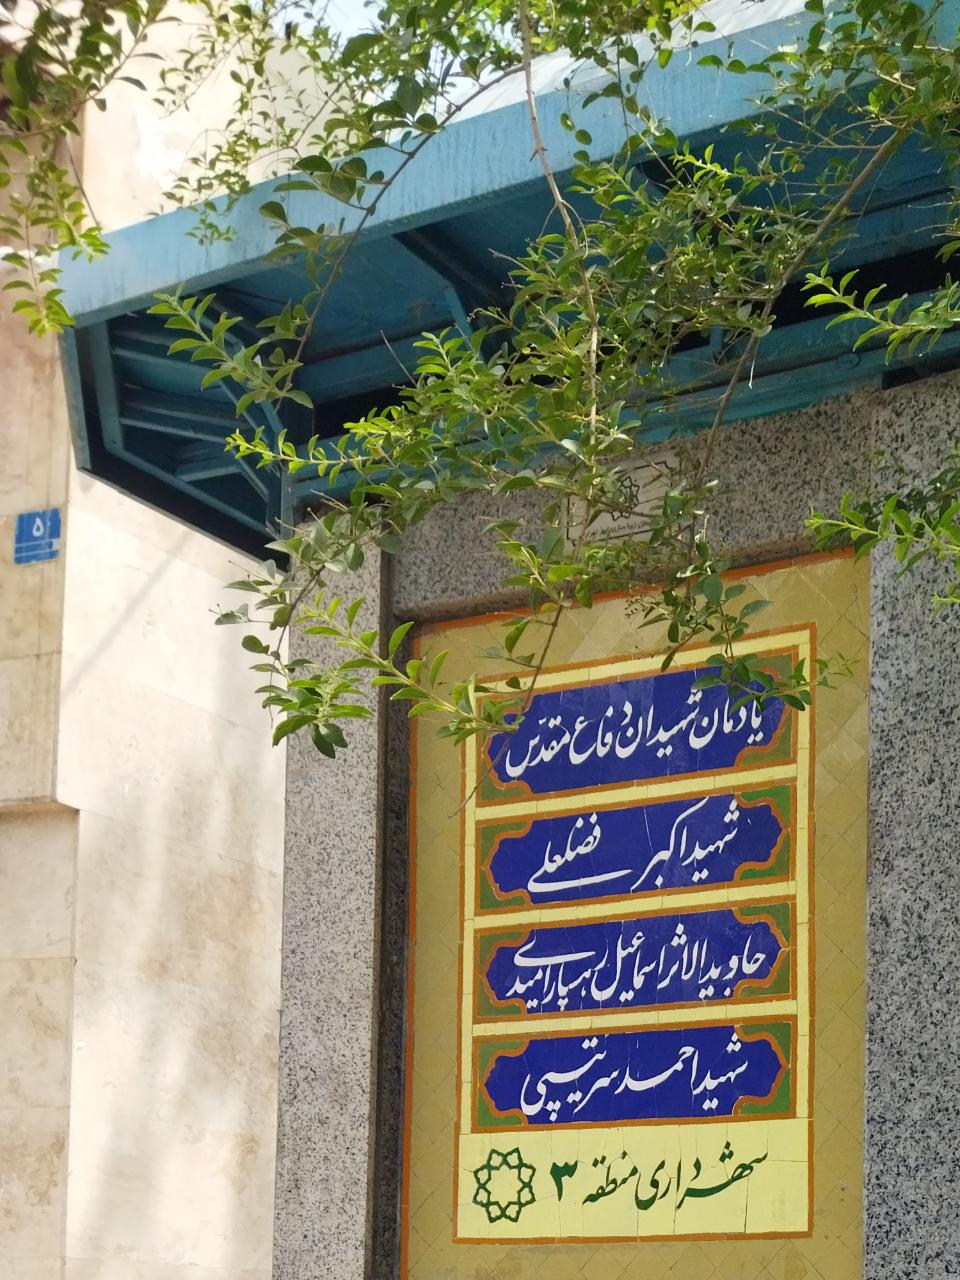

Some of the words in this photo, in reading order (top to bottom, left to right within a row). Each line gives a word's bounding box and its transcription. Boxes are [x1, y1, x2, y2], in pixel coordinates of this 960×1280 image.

[32, 516, 45, 538] ۵
[568, 700, 633, 765] دفاع
[614, 689, 703, 759] شهیدان
[688, 696, 764, 749] یادمان
[630, 796, 710, 891] اکبر
[682, 799, 740, 883] شهید
[590, 931, 666, 1002] اسماعیل
[614, 1045, 699, 1096] احمد
[695, 1033, 749, 1111] شهید
[549, 1159, 579, 1202] ۳
[581, 1149, 639, 1205] منطقه
[635, 1140, 769, 1211] شهرداری
